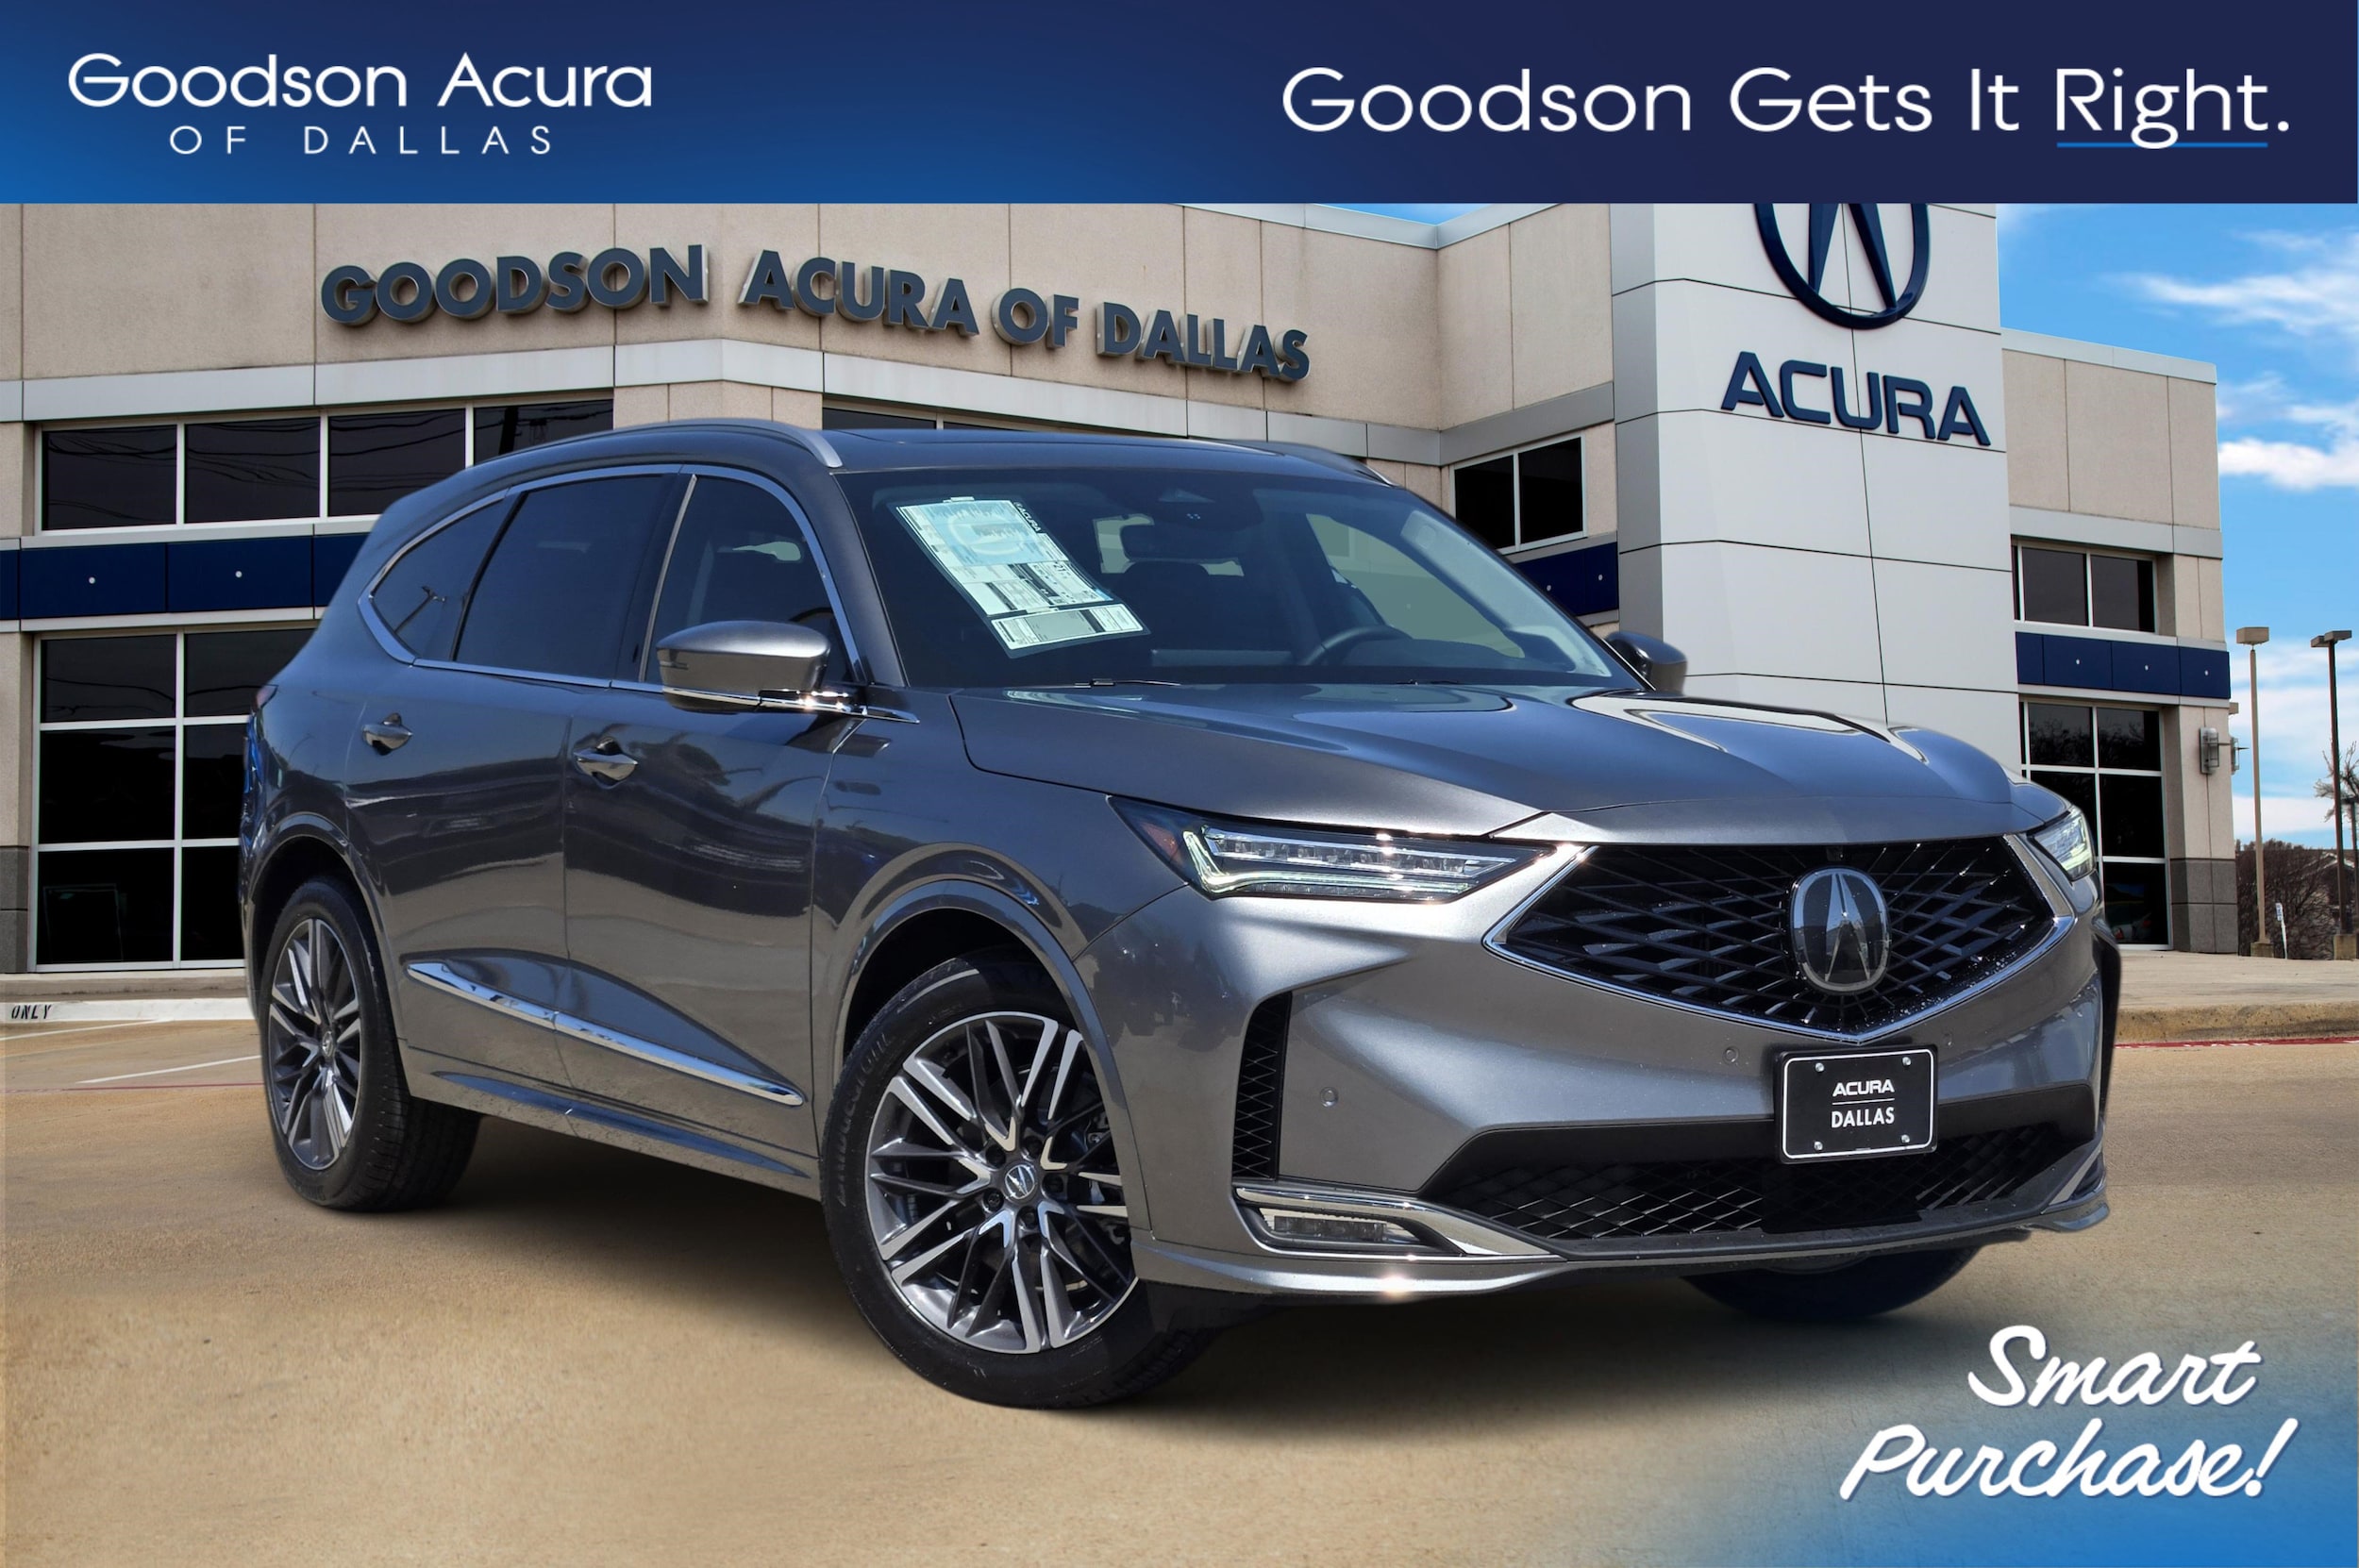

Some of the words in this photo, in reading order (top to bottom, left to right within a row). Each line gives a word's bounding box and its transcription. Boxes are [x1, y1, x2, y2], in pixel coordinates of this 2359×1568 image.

[321, 244, 708, 326] GOODSON
[737, 249, 980, 338] ACURA
[991, 287, 1080, 349] OF
[1096, 301, 1312, 383] DALLAS
[1721, 351, 1991, 448] ACURA
[1018, 507, 1041, 531] ACURA
[10, 1004, 53, 1020] ONLY
[1832, 1078, 1895, 1097] ACURA
[1831, 1106, 1895, 1128] DALLAS
